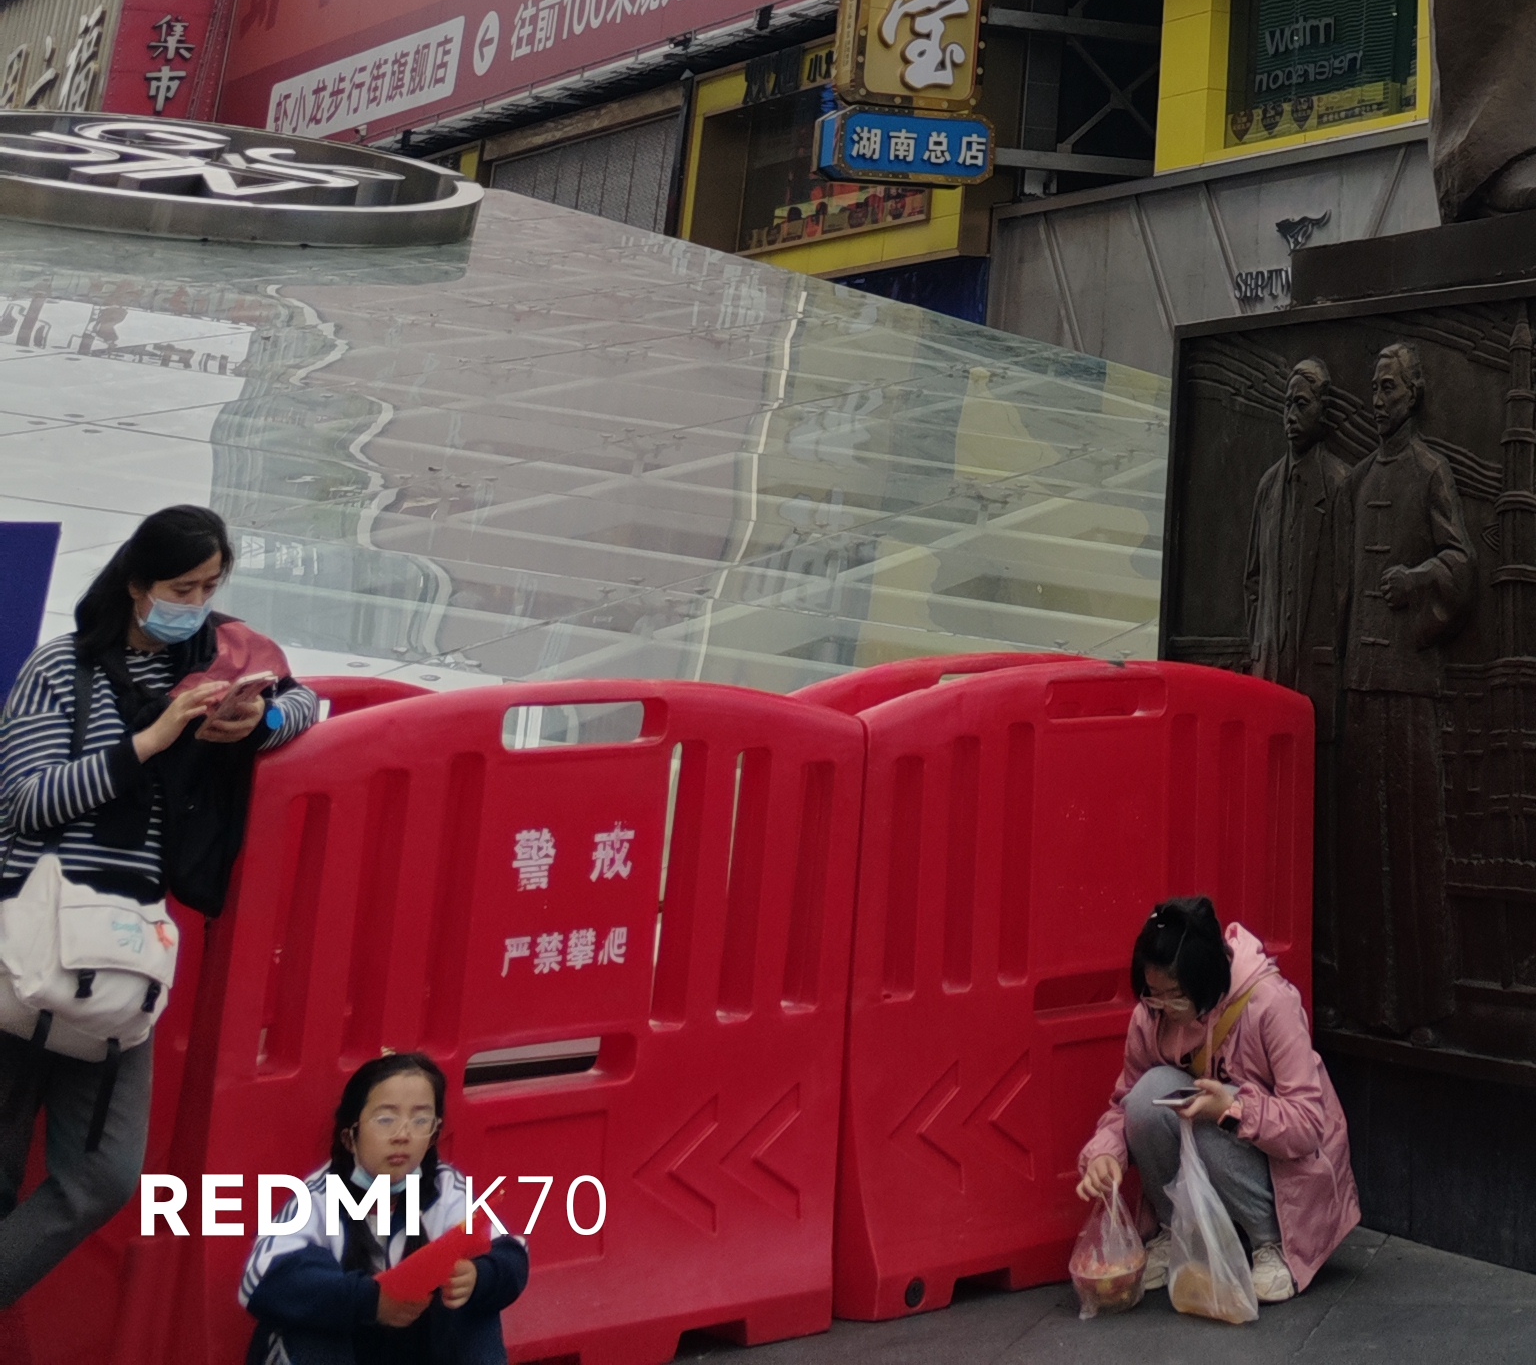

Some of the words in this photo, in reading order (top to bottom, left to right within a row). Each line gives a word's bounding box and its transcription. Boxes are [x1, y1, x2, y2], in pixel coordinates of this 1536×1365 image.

[145, 14, 196, 113] 集市
[273, 34, 455, 135] 虾小龙步行街旗舰店
[850, 125, 987, 168] 湖南总店
[512, 821, 635, 892] 警戒
[501, 927, 628, 977] 严禁攀爬
